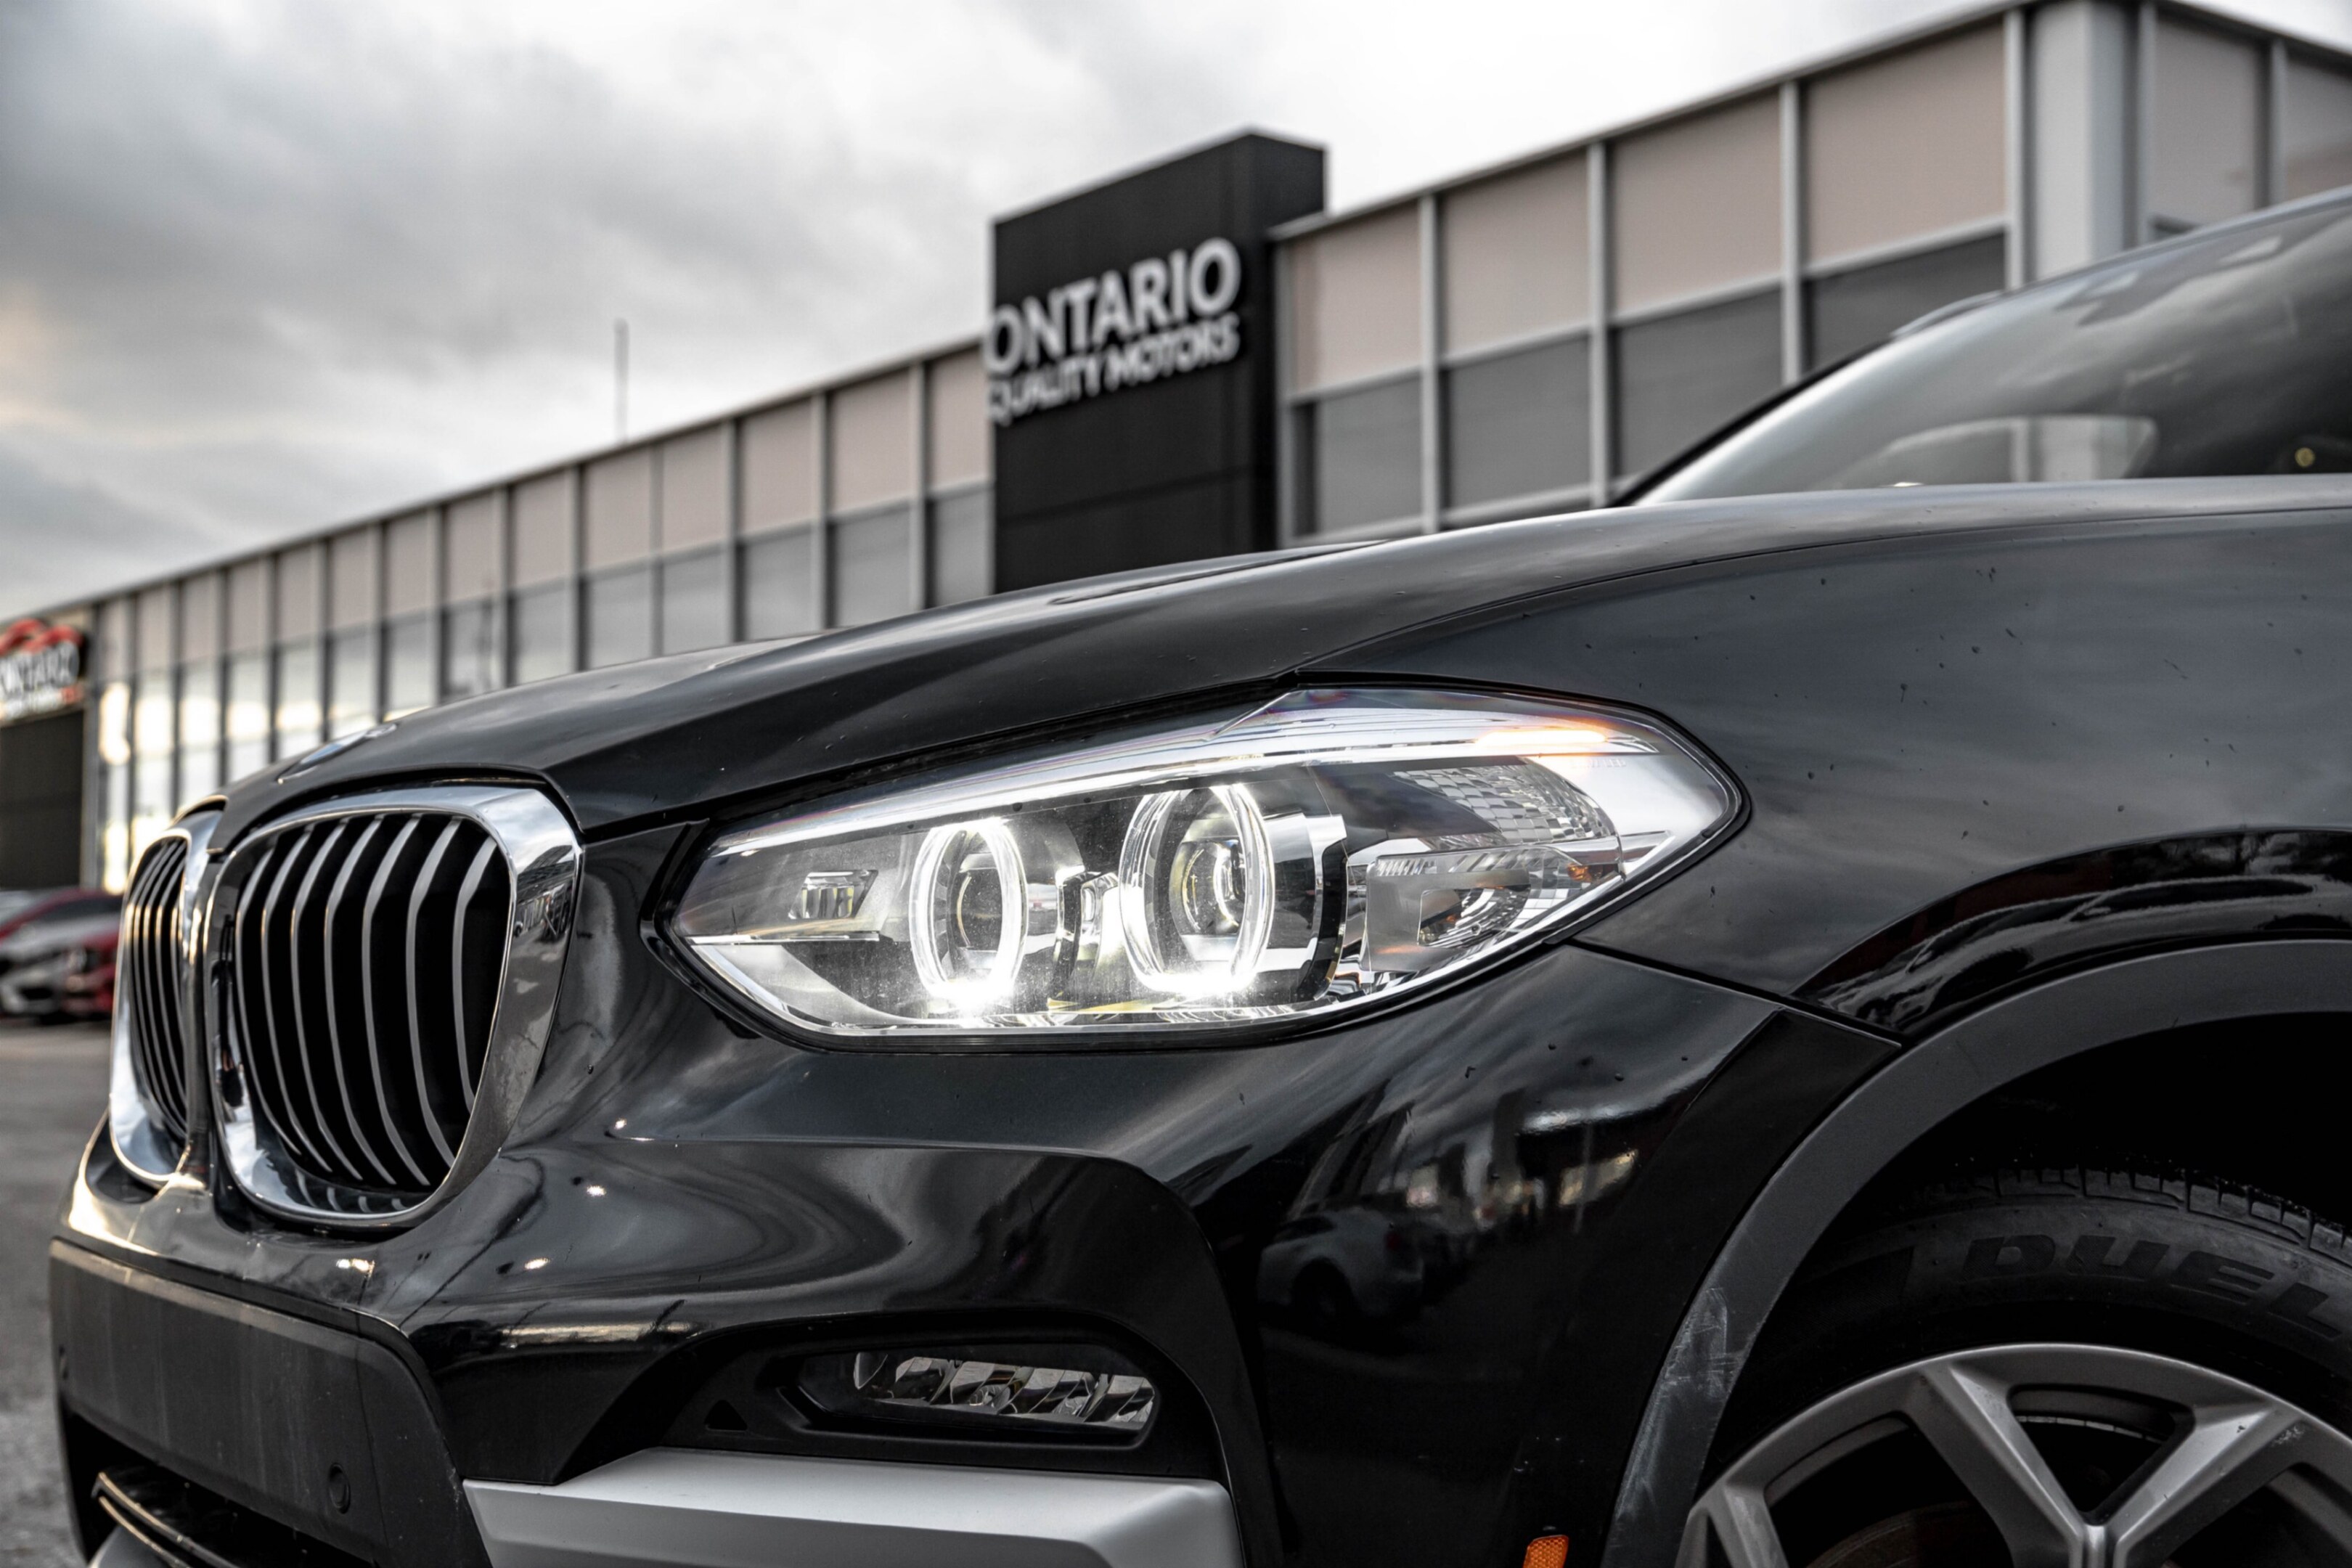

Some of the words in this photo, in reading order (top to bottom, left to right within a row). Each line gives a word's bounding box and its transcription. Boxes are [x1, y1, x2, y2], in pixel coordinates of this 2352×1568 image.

[984, 237, 1241, 376] ONTARIO
[1103, 311, 1241, 391] MOTORS
[1960, 1233, 2343, 1340] DUEL
